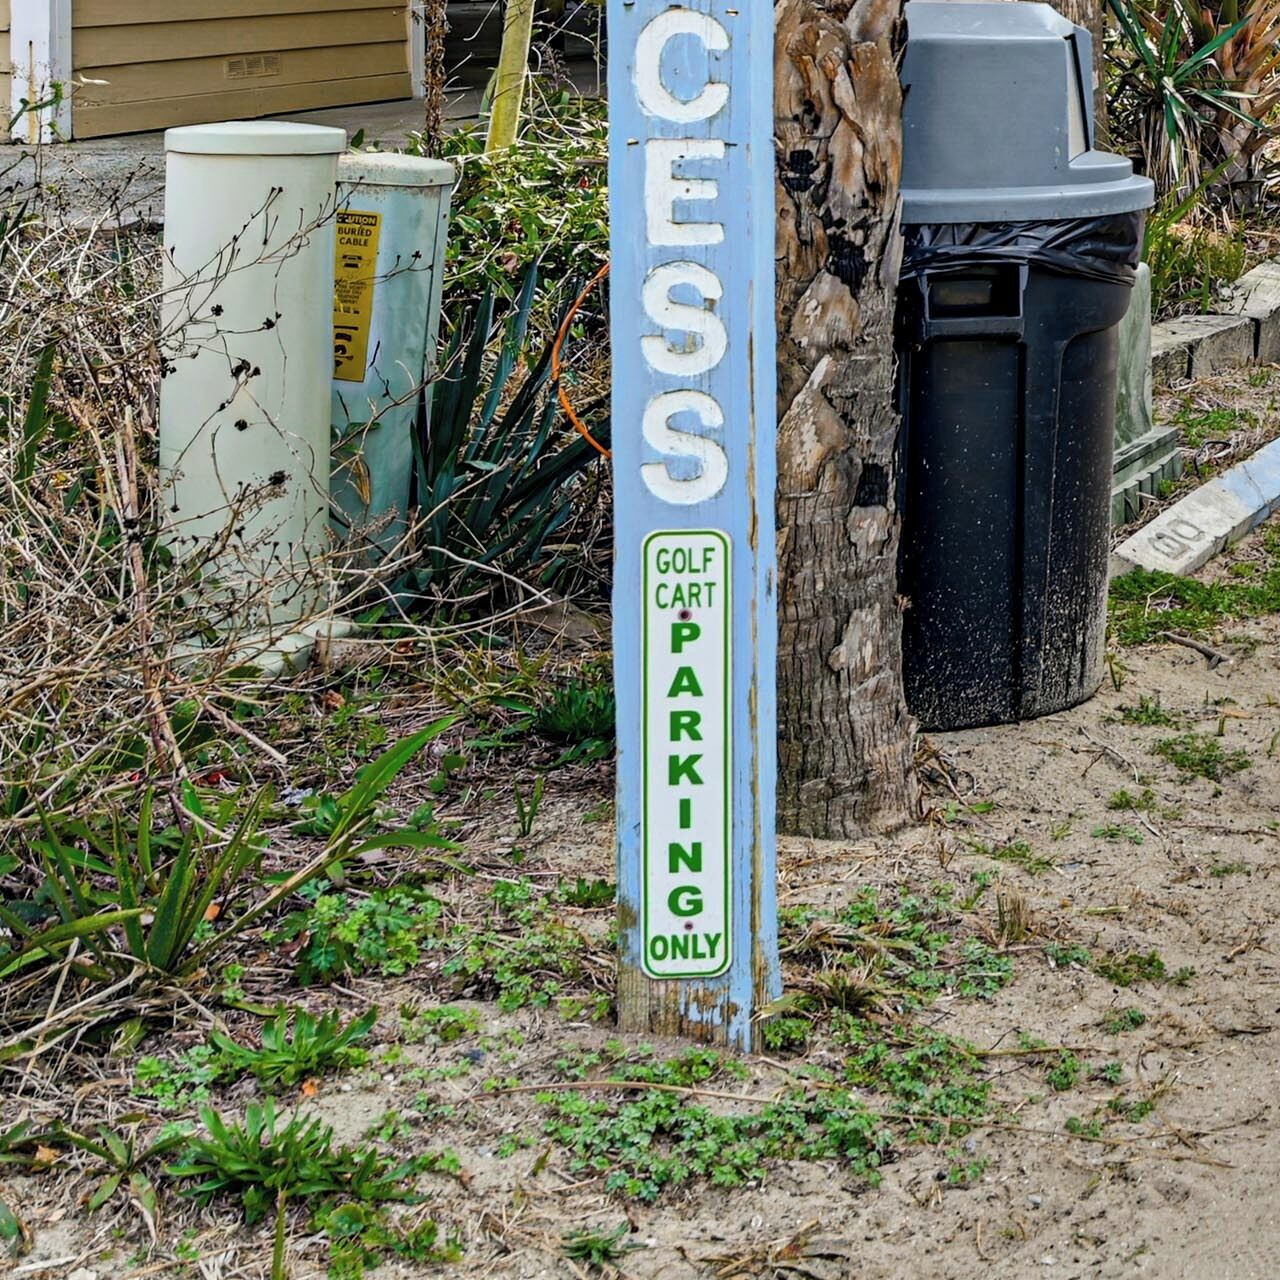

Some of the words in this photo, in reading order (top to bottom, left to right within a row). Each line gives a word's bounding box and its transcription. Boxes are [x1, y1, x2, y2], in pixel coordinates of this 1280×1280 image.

[337, 227, 372, 237] BURIED
[339, 237, 369, 247] CABLE
[656, 547, 716, 574] GOLF
[655, 582, 717, 610] CART
[667, 623, 704, 918] PARKING
[649, 932, 722, 961] ONLY
